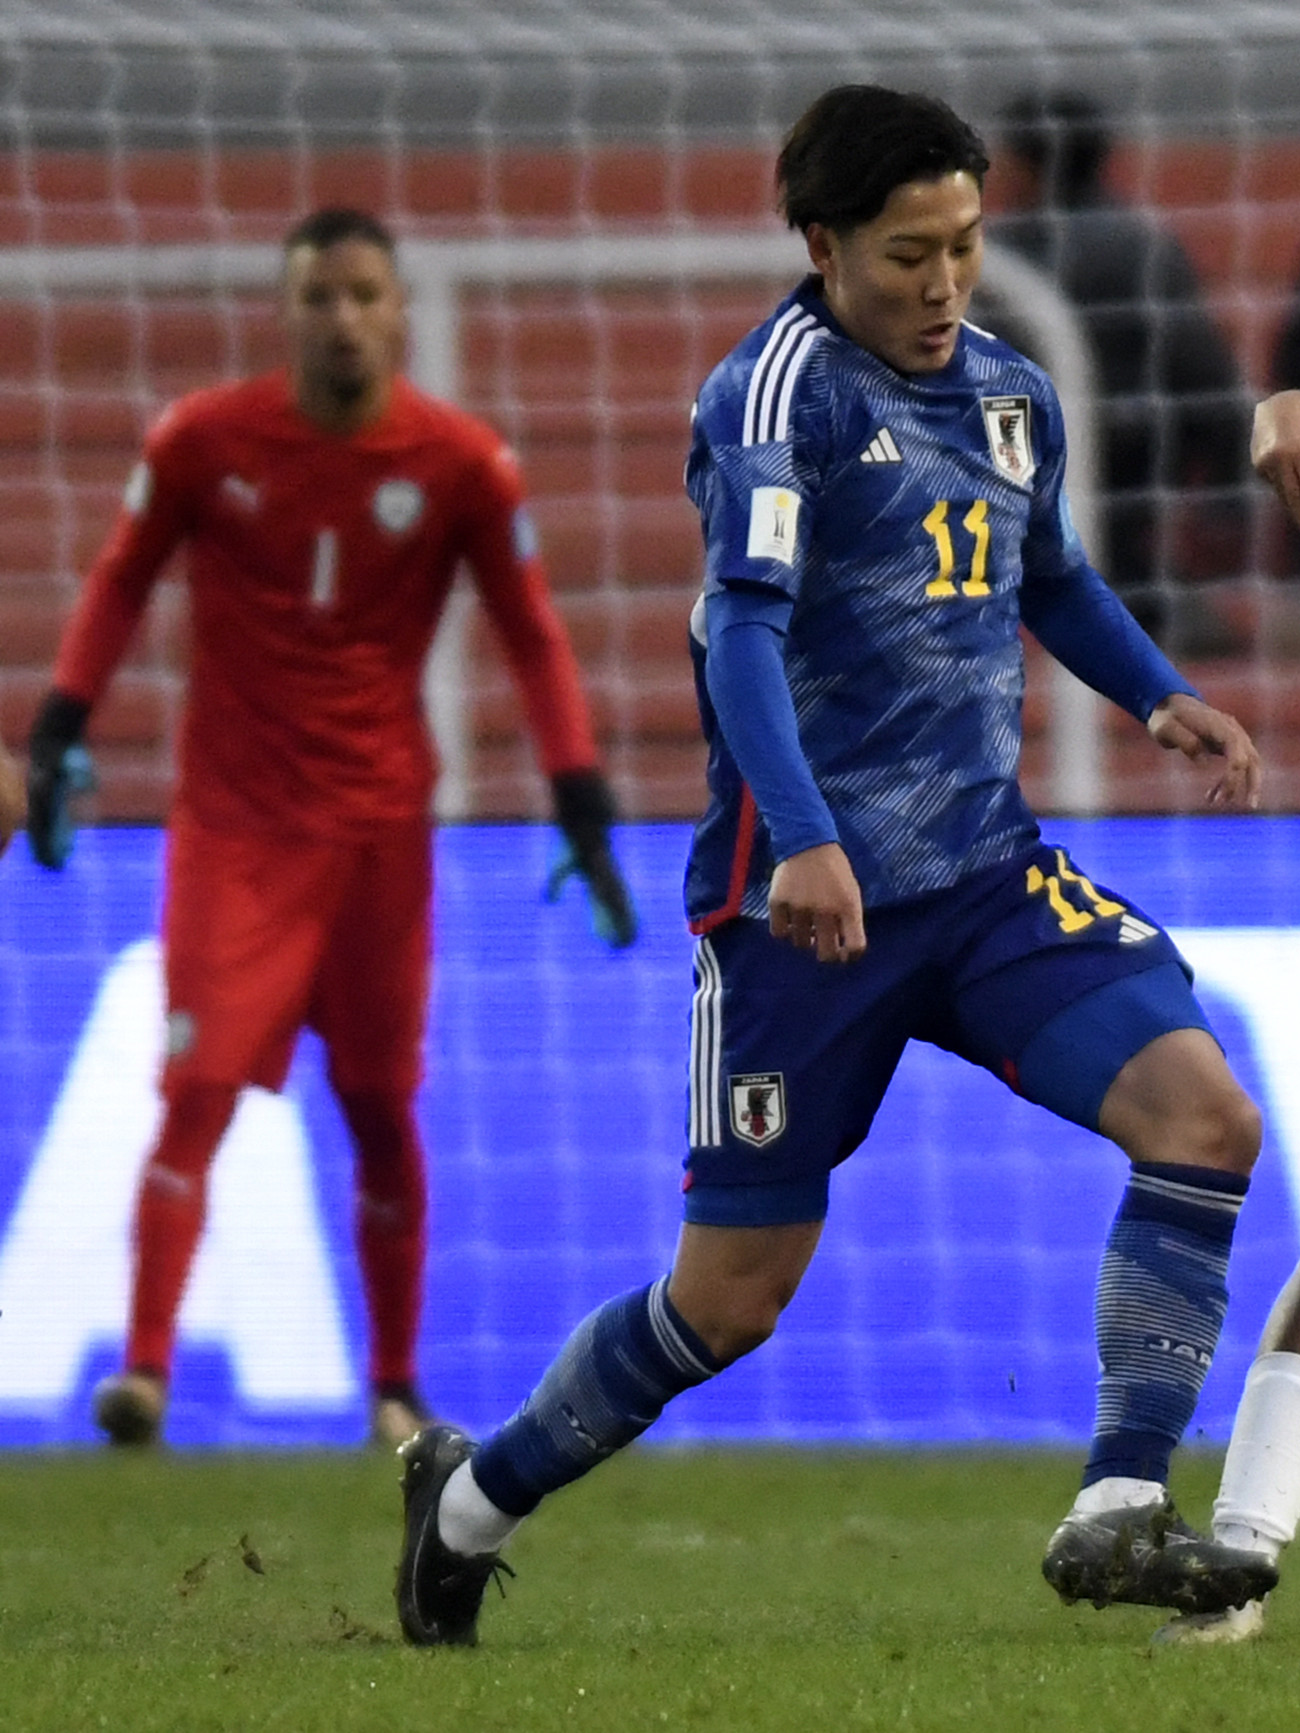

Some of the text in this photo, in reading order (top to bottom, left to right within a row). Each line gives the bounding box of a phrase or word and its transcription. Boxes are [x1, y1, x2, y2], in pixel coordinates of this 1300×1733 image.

[313, 529, 336, 604] 1
[922, 499, 992, 597] 11
[1025, 849, 1127, 933] 11
